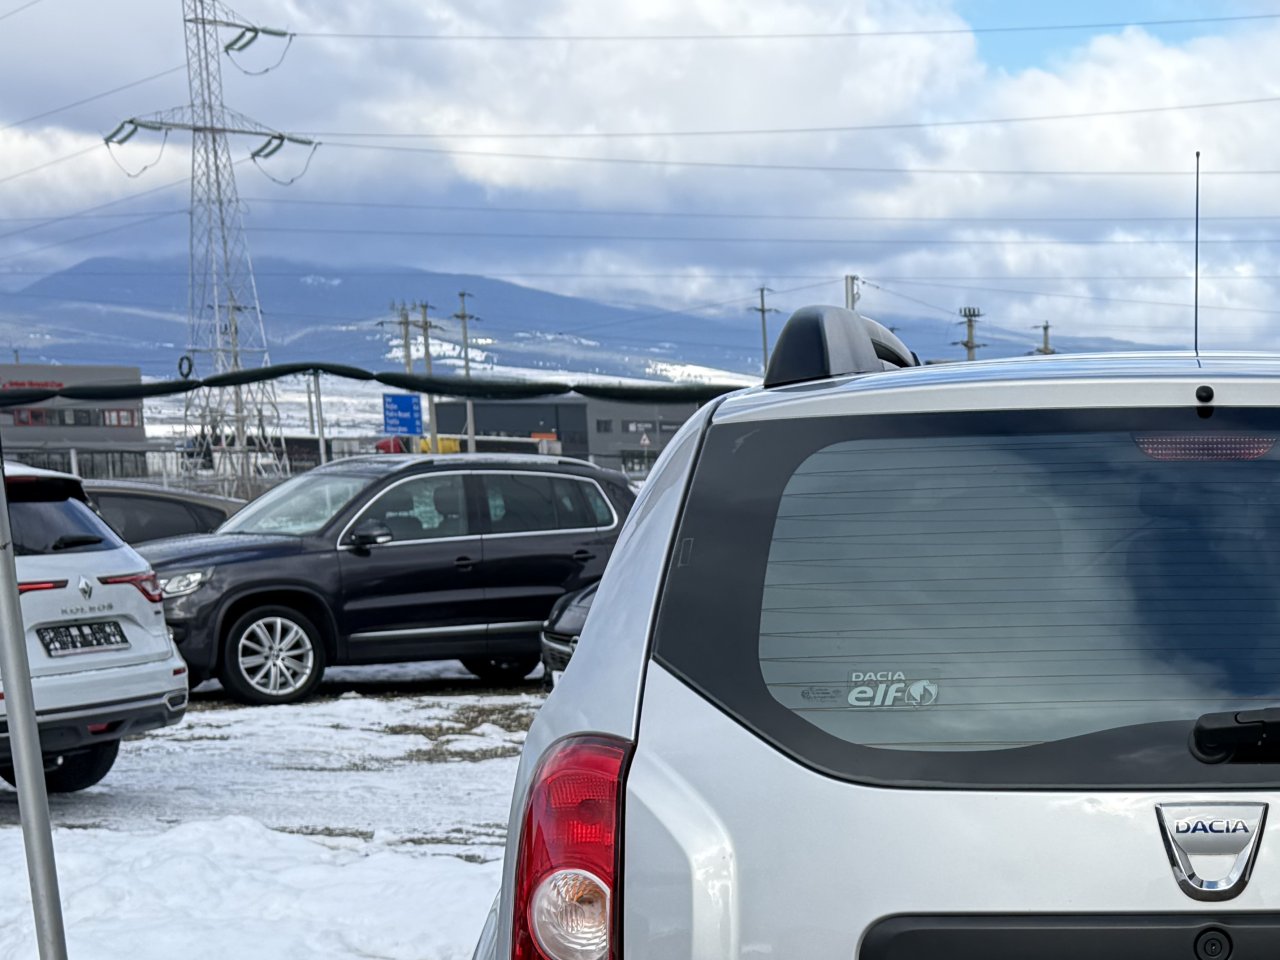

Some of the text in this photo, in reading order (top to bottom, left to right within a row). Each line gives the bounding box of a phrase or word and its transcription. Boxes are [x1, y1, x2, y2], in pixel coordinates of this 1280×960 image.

[852, 671, 905, 681] DACIA
[848, 682, 905, 706] elf
[1175, 820, 1249, 833] DACIA
